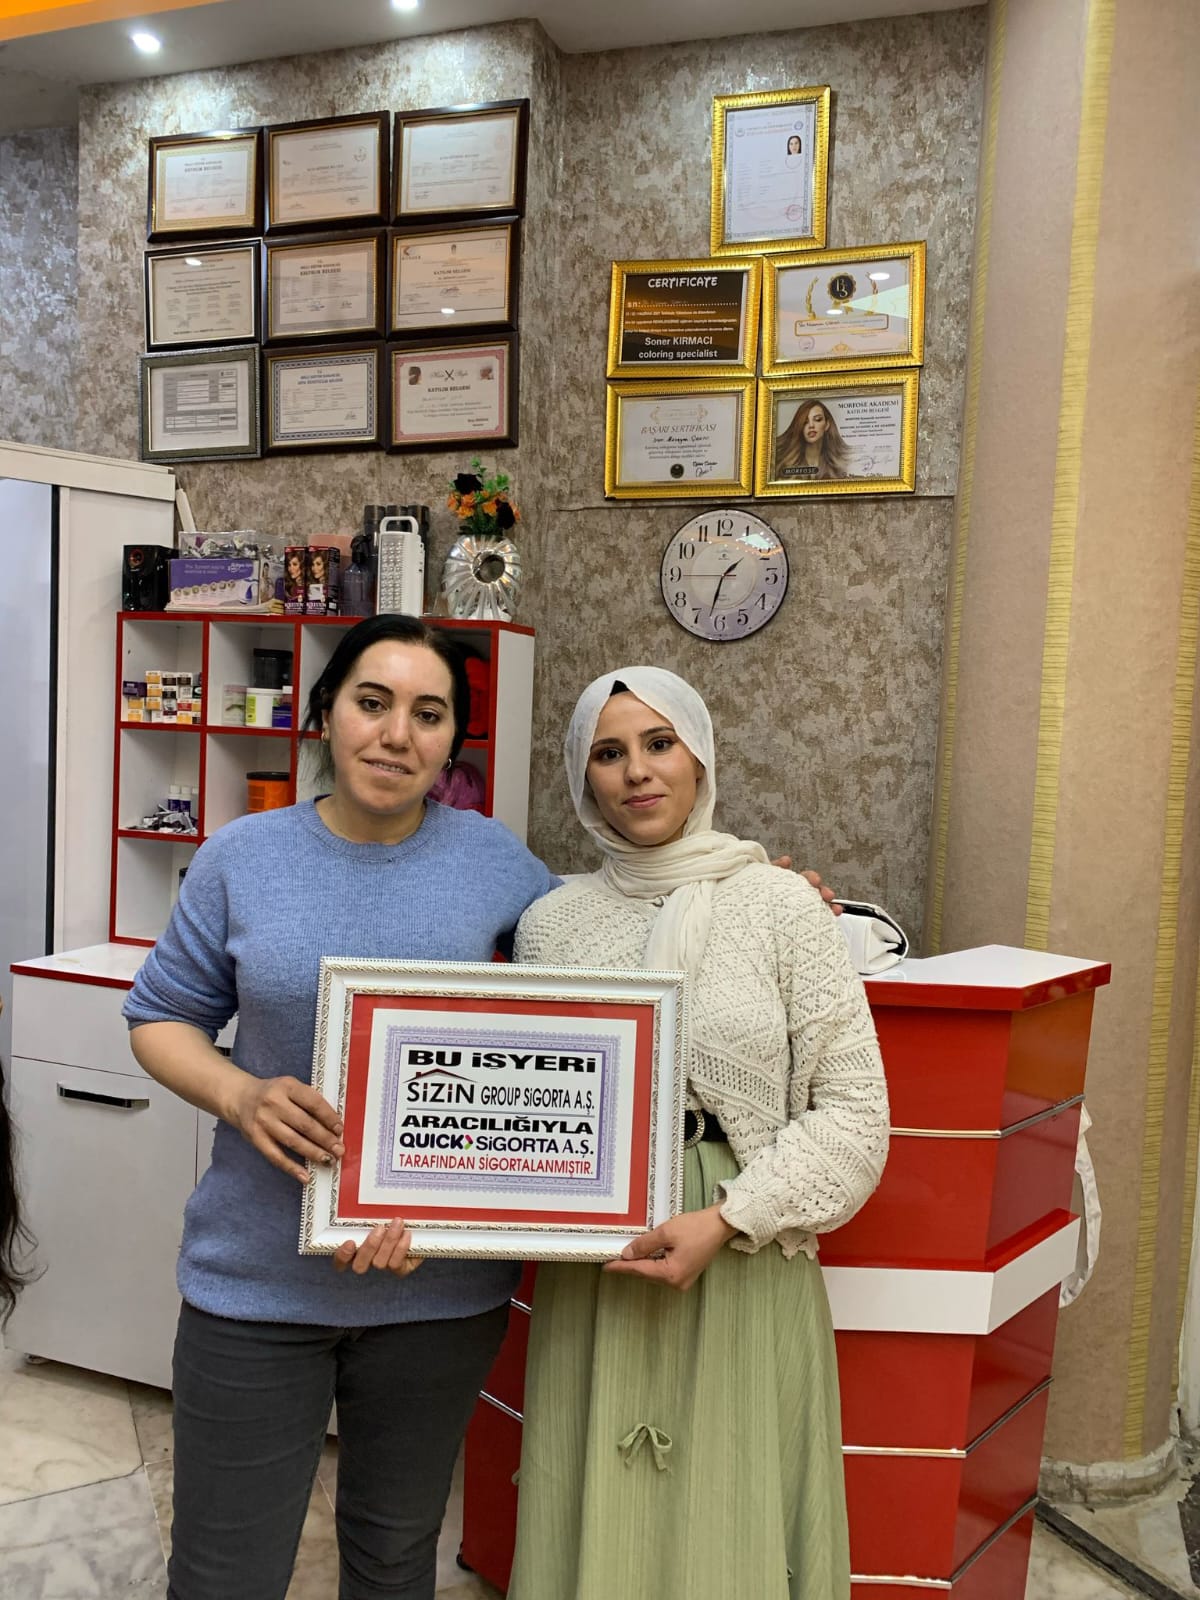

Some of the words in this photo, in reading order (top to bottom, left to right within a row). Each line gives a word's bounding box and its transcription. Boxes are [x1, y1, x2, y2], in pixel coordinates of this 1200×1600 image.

[648, 276, 718, 289] CERTIFICATE
[645, 337, 670, 346] Soner
[673, 336, 713, 345] KIRMACI
[638, 350, 673, 360] coloring
[676, 349, 718, 359] specialist
[838, 401, 868, 410] MORFOSE
[699, 525, 708, 542] 11
[717, 519, 733, 536] 12
[679, 542, 695, 559] 10
[670, 566, 681, 583] 9
[765, 567, 778, 585] 3
[675, 592, 686, 608] 8
[692, 608, 702, 624] 7
[714, 615, 725, 631] 6
[737, 608, 749, 626] 5
[408, 1050, 461, 1067] BU
[481, 1086, 520, 1106] GROUP
[574, 1090, 595, 1114] A.Ş.
[401, 1115, 594, 1135] ARACILIĞIYLA
[399, 1132, 464, 1150] QUICK
[562, 1139, 595, 1158] A.Ş.
[399, 1154, 475, 1170] TARAFINDAN
